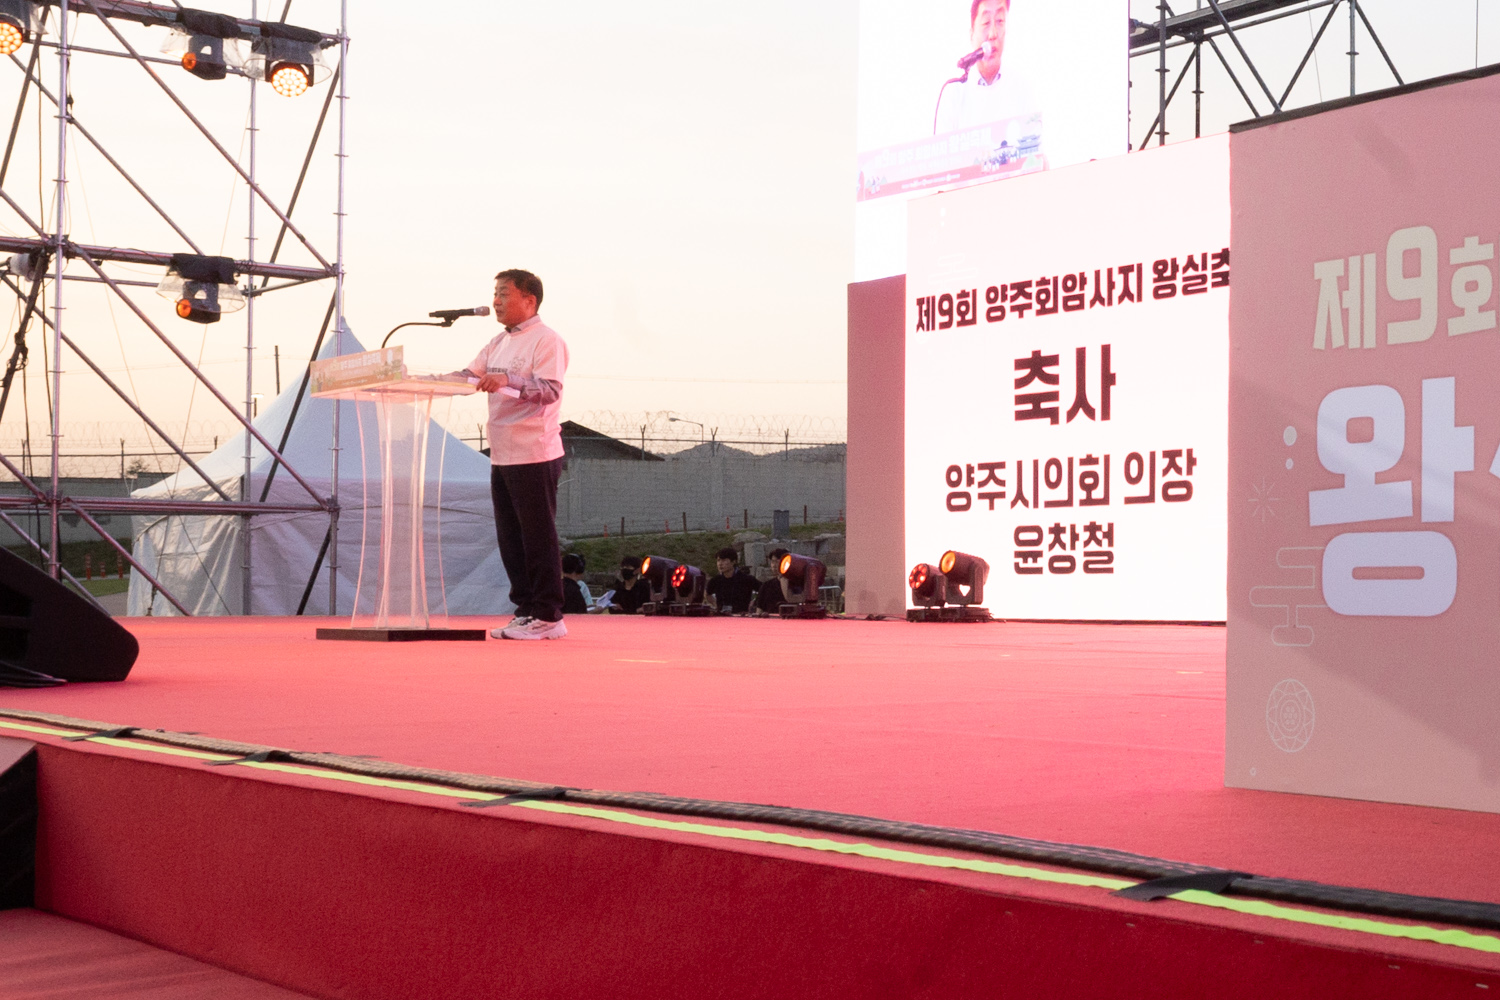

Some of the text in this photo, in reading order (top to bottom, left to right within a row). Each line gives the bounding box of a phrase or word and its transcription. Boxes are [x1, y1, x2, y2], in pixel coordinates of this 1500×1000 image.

[916, 288, 978, 334] 제9회
[985, 263, 1143, 323] 양주회암사지
[1013, 343, 1116, 425] 축사
[945, 447, 1197, 512] 양주시의회 의장
[1012, 520, 1115, 575] 윤창철
